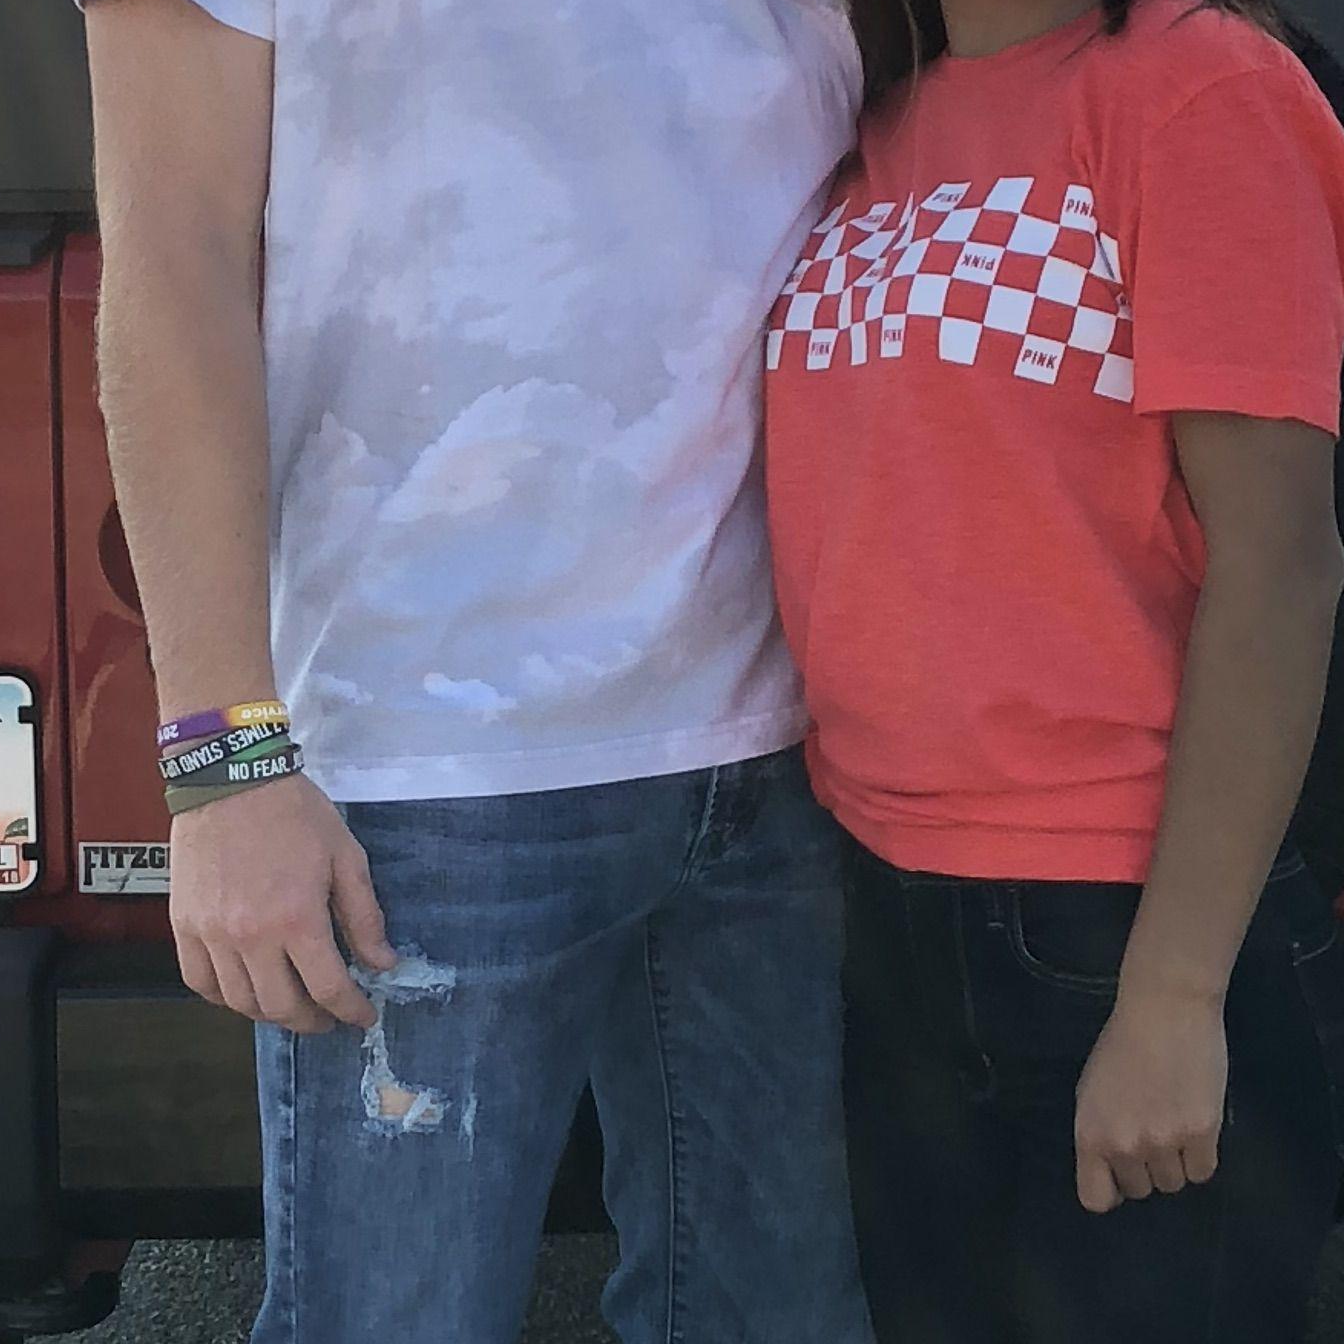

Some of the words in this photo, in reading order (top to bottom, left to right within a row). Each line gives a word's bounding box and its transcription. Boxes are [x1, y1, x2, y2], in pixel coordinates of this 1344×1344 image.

[1065, 199, 1093, 217] PIN
[961, 254, 996, 271] PINK
[1021, 349, 1057, 369] PINK
[179, 742, 224, 773] STAND
[228, 762, 250, 780] NO
[82, 846, 171, 886] FITZG
